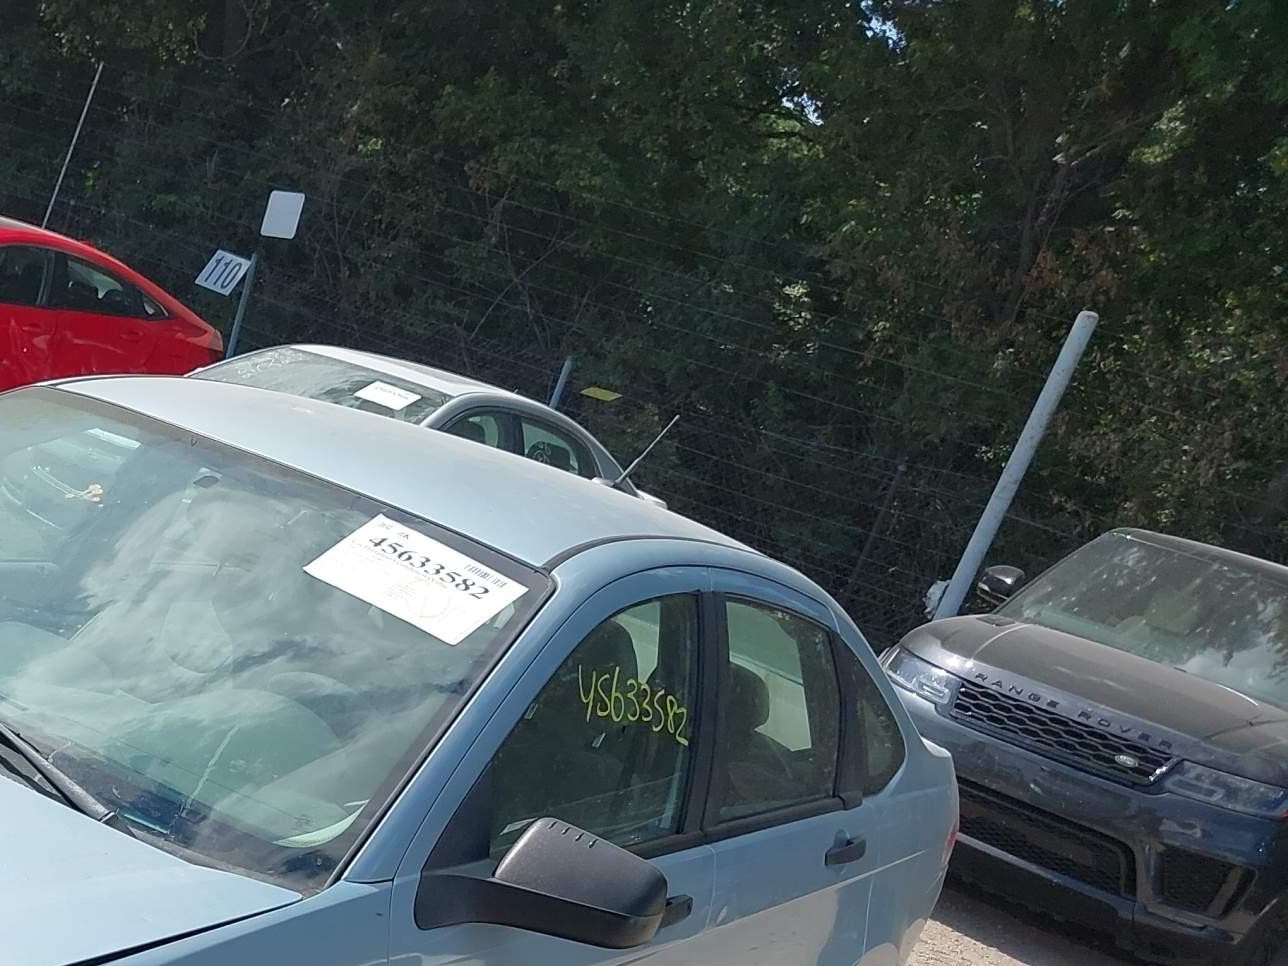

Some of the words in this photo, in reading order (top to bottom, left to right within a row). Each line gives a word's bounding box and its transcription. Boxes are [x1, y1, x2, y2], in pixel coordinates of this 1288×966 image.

[204, 255, 243, 290] 110
[368, 536, 491, 600] 45633582
[578, 663, 689, 747] 45633582
[974, 671, 1061, 709] RANGE
[1077, 709, 1174, 750] ROVER
